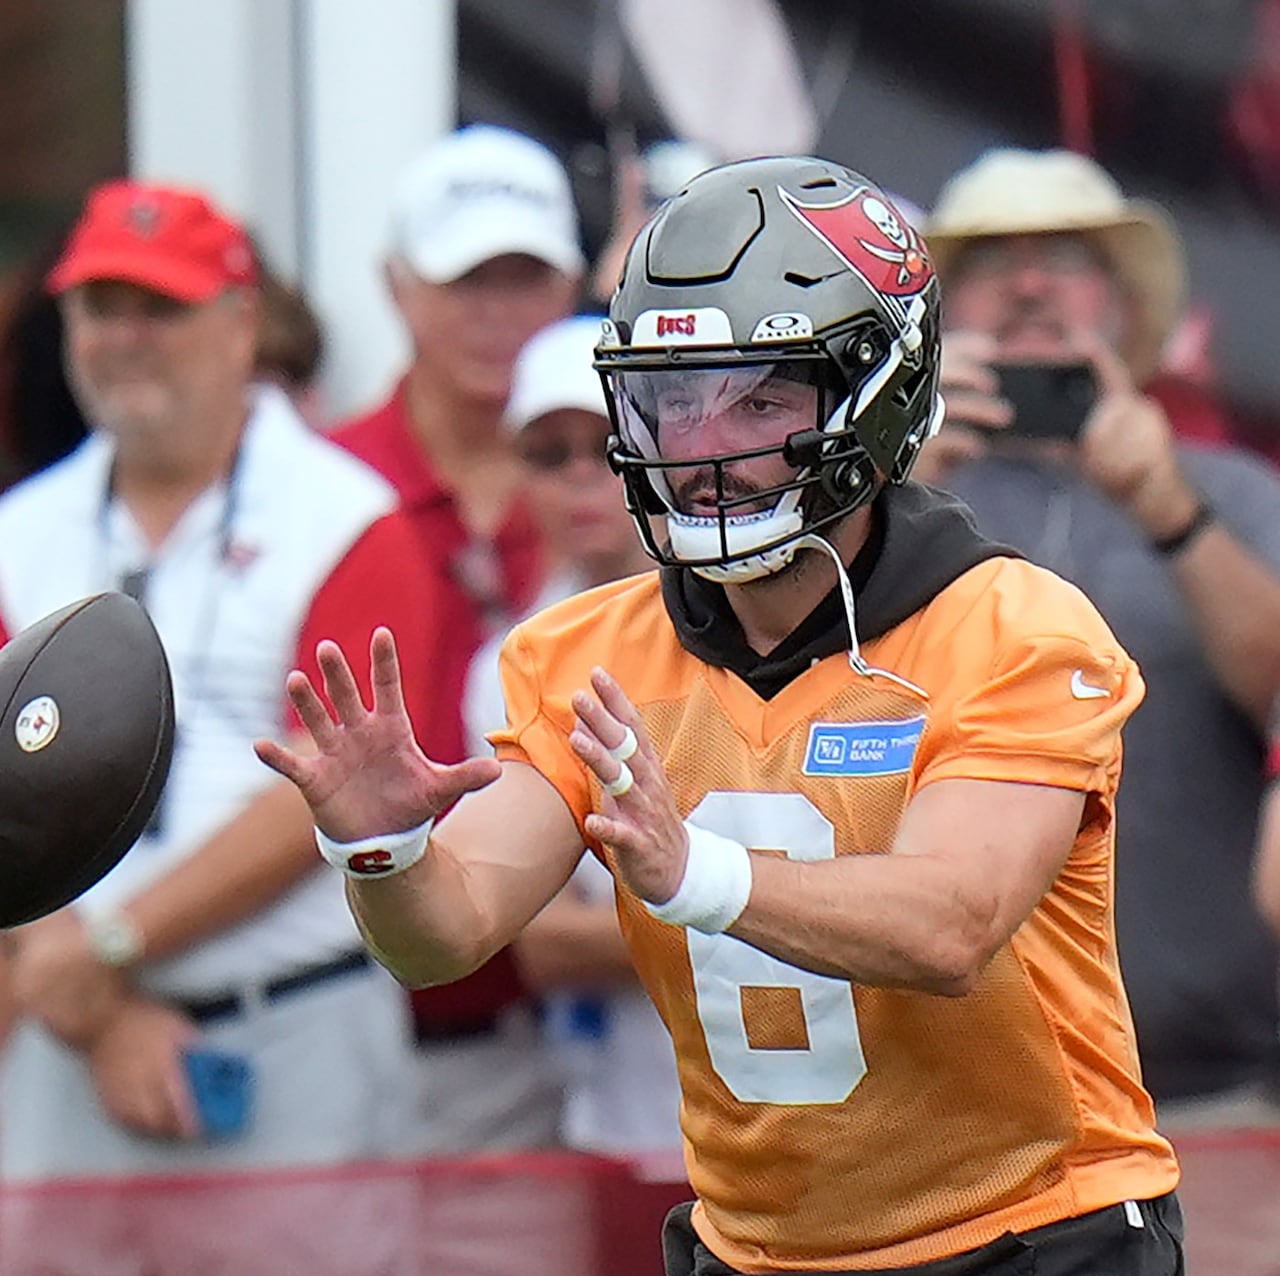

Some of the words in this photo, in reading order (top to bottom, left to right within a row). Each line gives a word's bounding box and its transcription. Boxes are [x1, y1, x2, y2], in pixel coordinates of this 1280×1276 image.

[757, 328, 809, 340] OAKLEY
[851, 738, 888, 750] FIFTH
[849, 749, 885, 761] BANK
[683, 790, 868, 1105] 6
